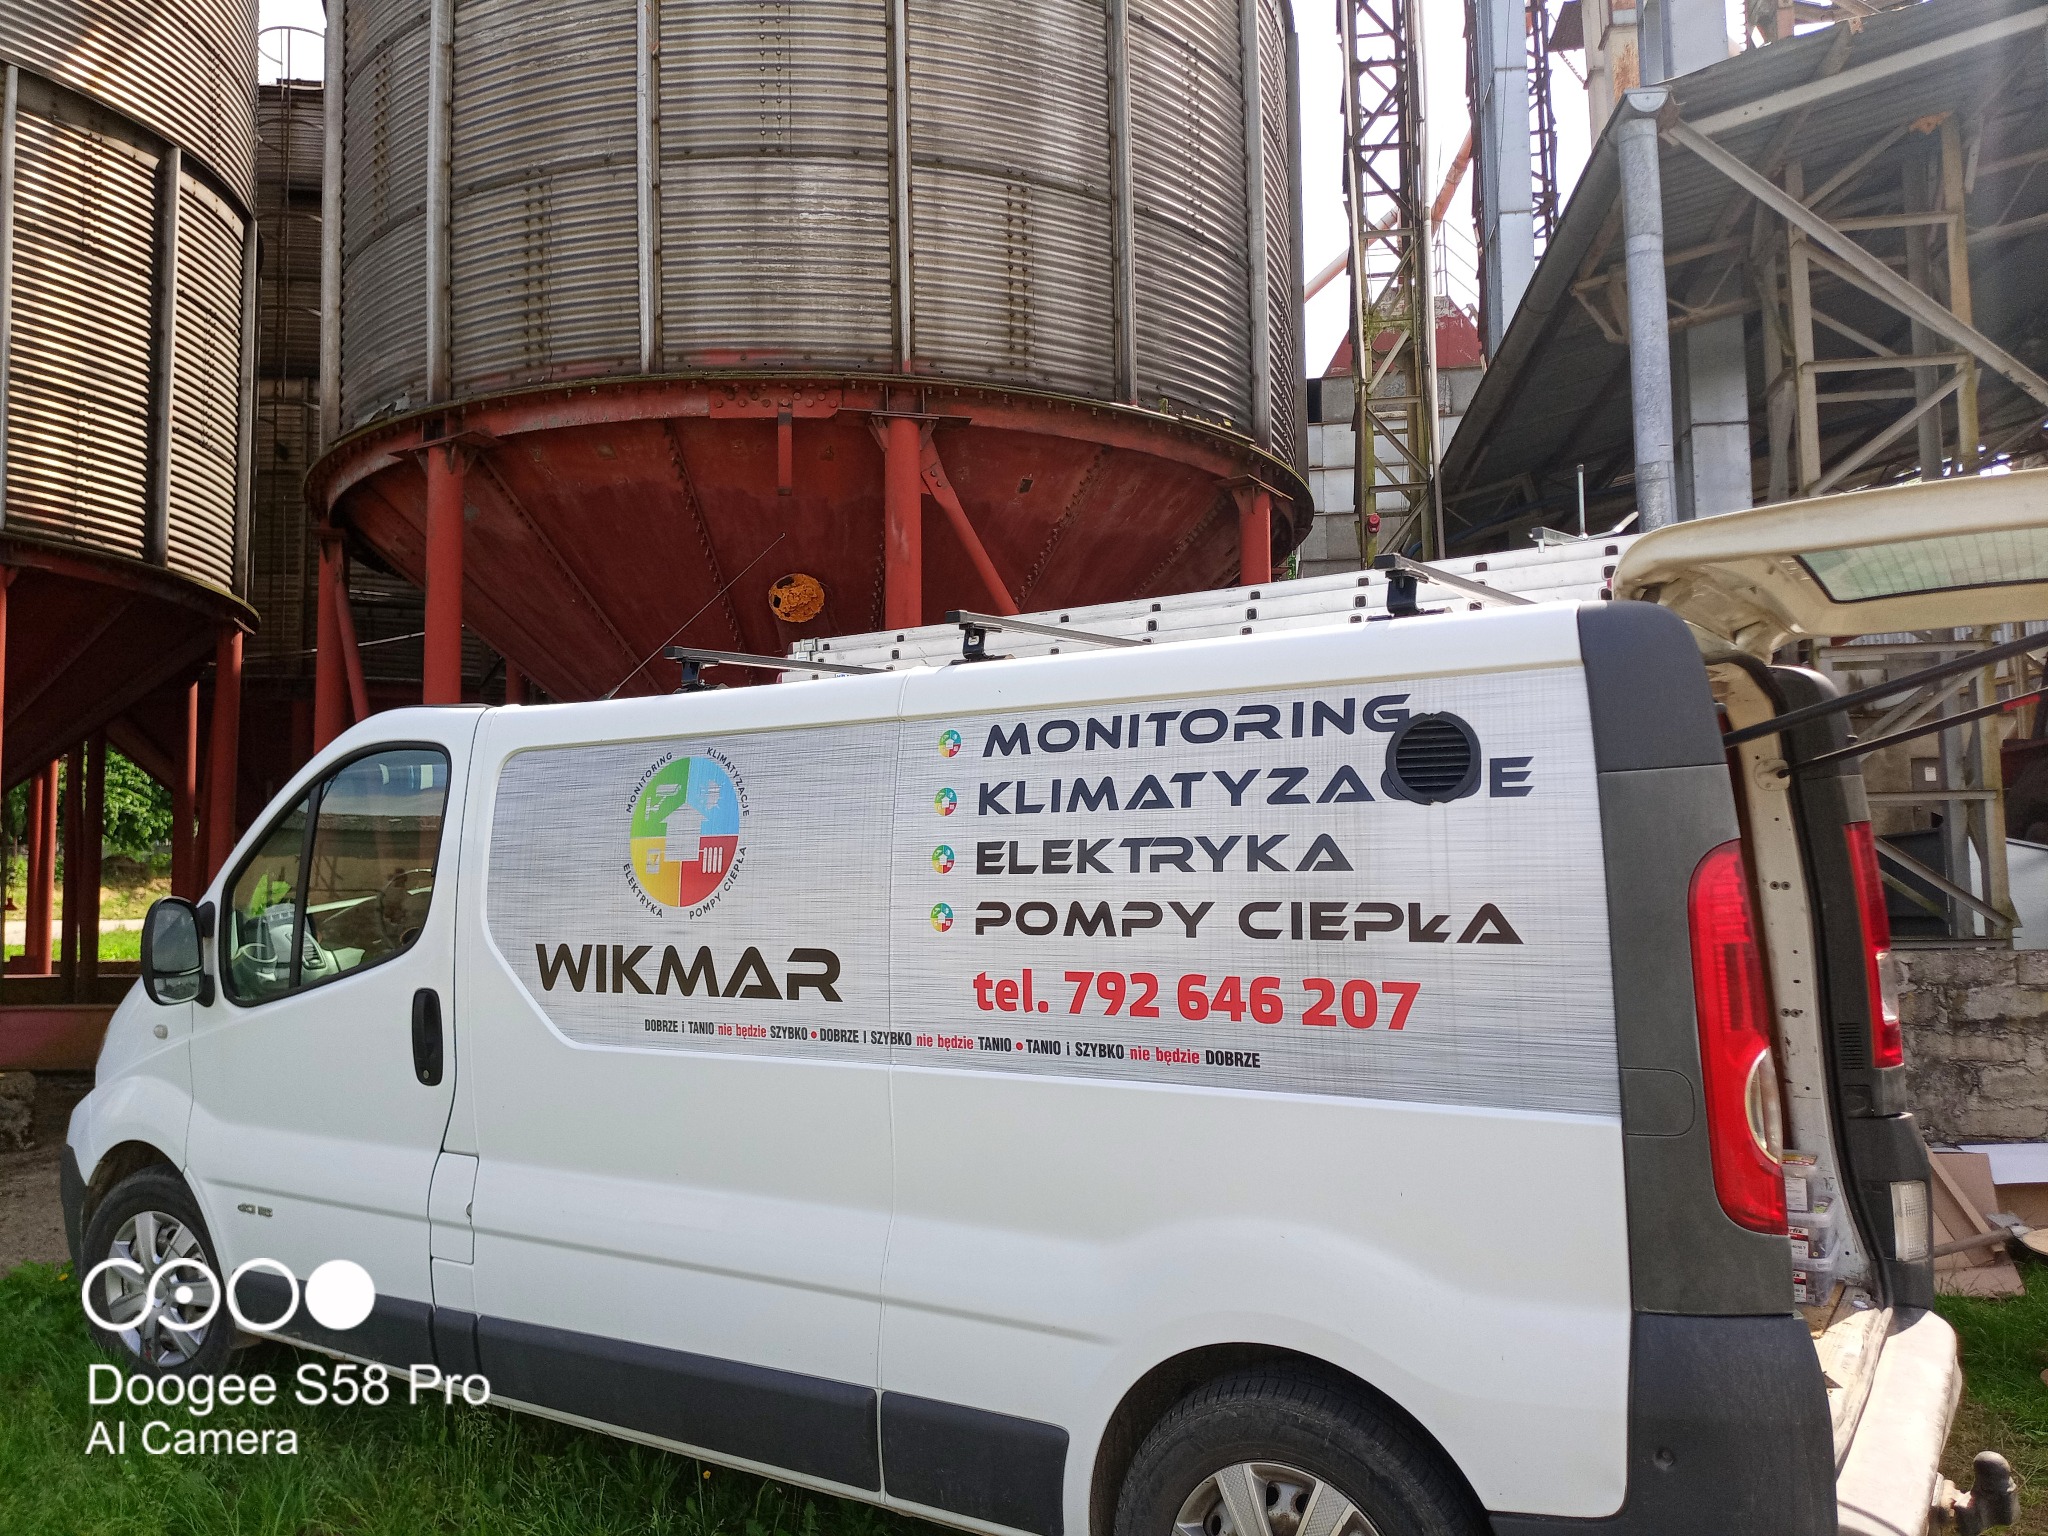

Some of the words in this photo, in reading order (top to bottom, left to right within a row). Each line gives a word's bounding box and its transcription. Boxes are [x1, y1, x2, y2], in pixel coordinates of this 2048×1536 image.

[981, 693, 1412, 758] MONITORING
[626, 751, 673, 813] MONITORING
[705, 747, 750, 817] KLIMATYZACJE
[689, 895, 722, 920] POMPY
[723, 846, 748, 892] CIEPŁA
[975, 833, 1354, 875] ELEKTRYKA
[623, 863, 664, 919] ELEKTRYKA
[974, 901, 1215, 938] POMPY
[1238, 902, 1524, 945] CIEPŁA
[535, 943, 844, 1002] WIKMAR
[973, 968, 1049, 1013] tel.
[1064, 971, 1160, 1019] 792
[1177, 973, 1284, 1025] 646
[1301, 978, 1421, 1031] 207
[644, 1018, 679, 1033] DOBRZE
[681, 1020, 685, 1034] i
[687, 1021, 715, 1035] TANIO
[717, 1023, 733, 1036] nie
[735, 1023, 767, 1040] będzie
[769, 1025, 808, 1040] SZYBKO
[819, 1028, 859, 1043] DOBRZE
[863, 1030, 867, 1044] I
[870, 1031, 912, 1046] SZYBKO
[916, 1033, 933, 1047] nie
[937, 1034, 974, 1051] będzie
[977, 1036, 1012, 1052] TANIO
[1025, 1038, 1061, 1055] TANIO
[1066, 1041, 1070, 1056] i
[1075, 1042, 1125, 1060] SZYBKO
[1130, 1045, 1150, 1061] nie
[1155, 1046, 1200, 1066] będzie
[1205, 1049, 1261, 1069] DOBRZE
